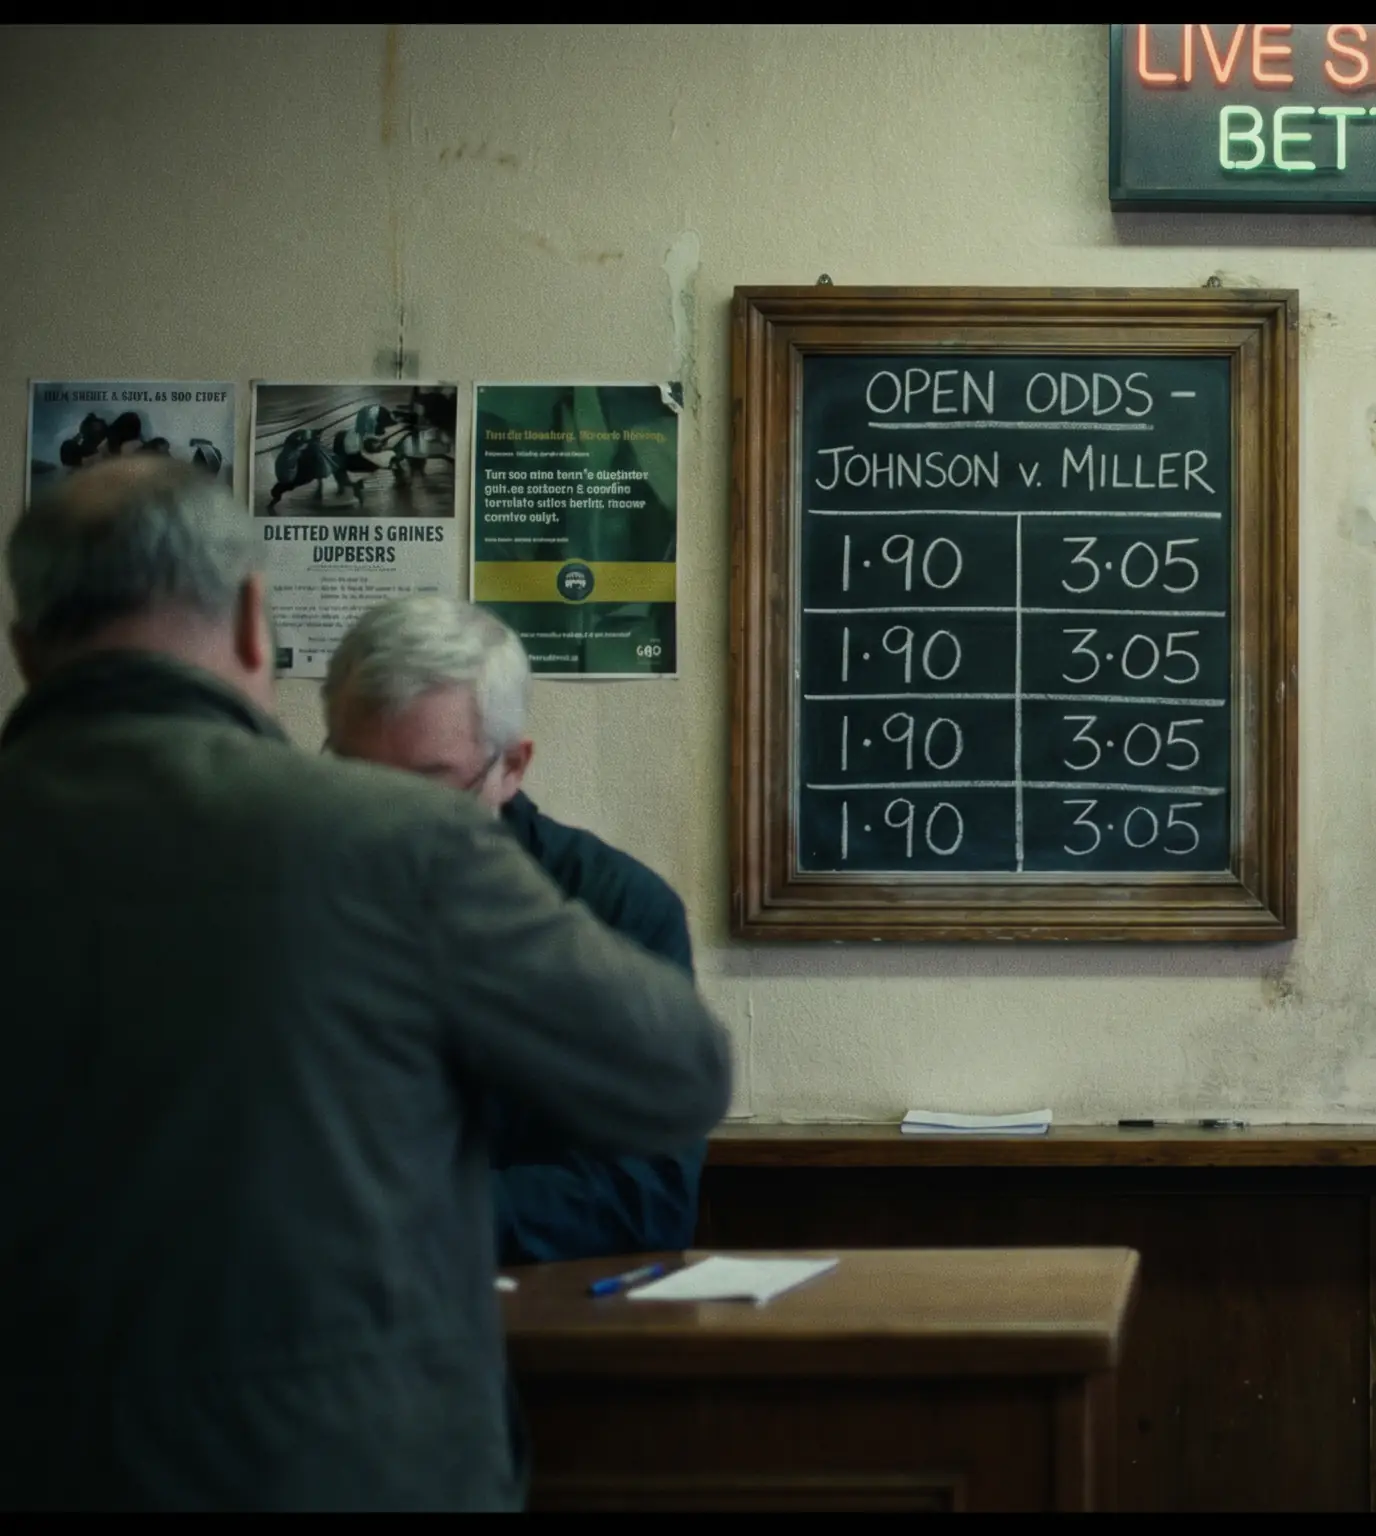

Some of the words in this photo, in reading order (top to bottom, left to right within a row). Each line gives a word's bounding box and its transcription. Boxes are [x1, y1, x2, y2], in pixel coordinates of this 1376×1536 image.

[1136, 24, 1295, 84] LIVE
[866, 368, 995, 415] OPEN
[1026, 371, 1154, 416] ODDS
[814, 445, 1001, 490] JOHNSON
[1062, 444, 1216, 494] MILLER
